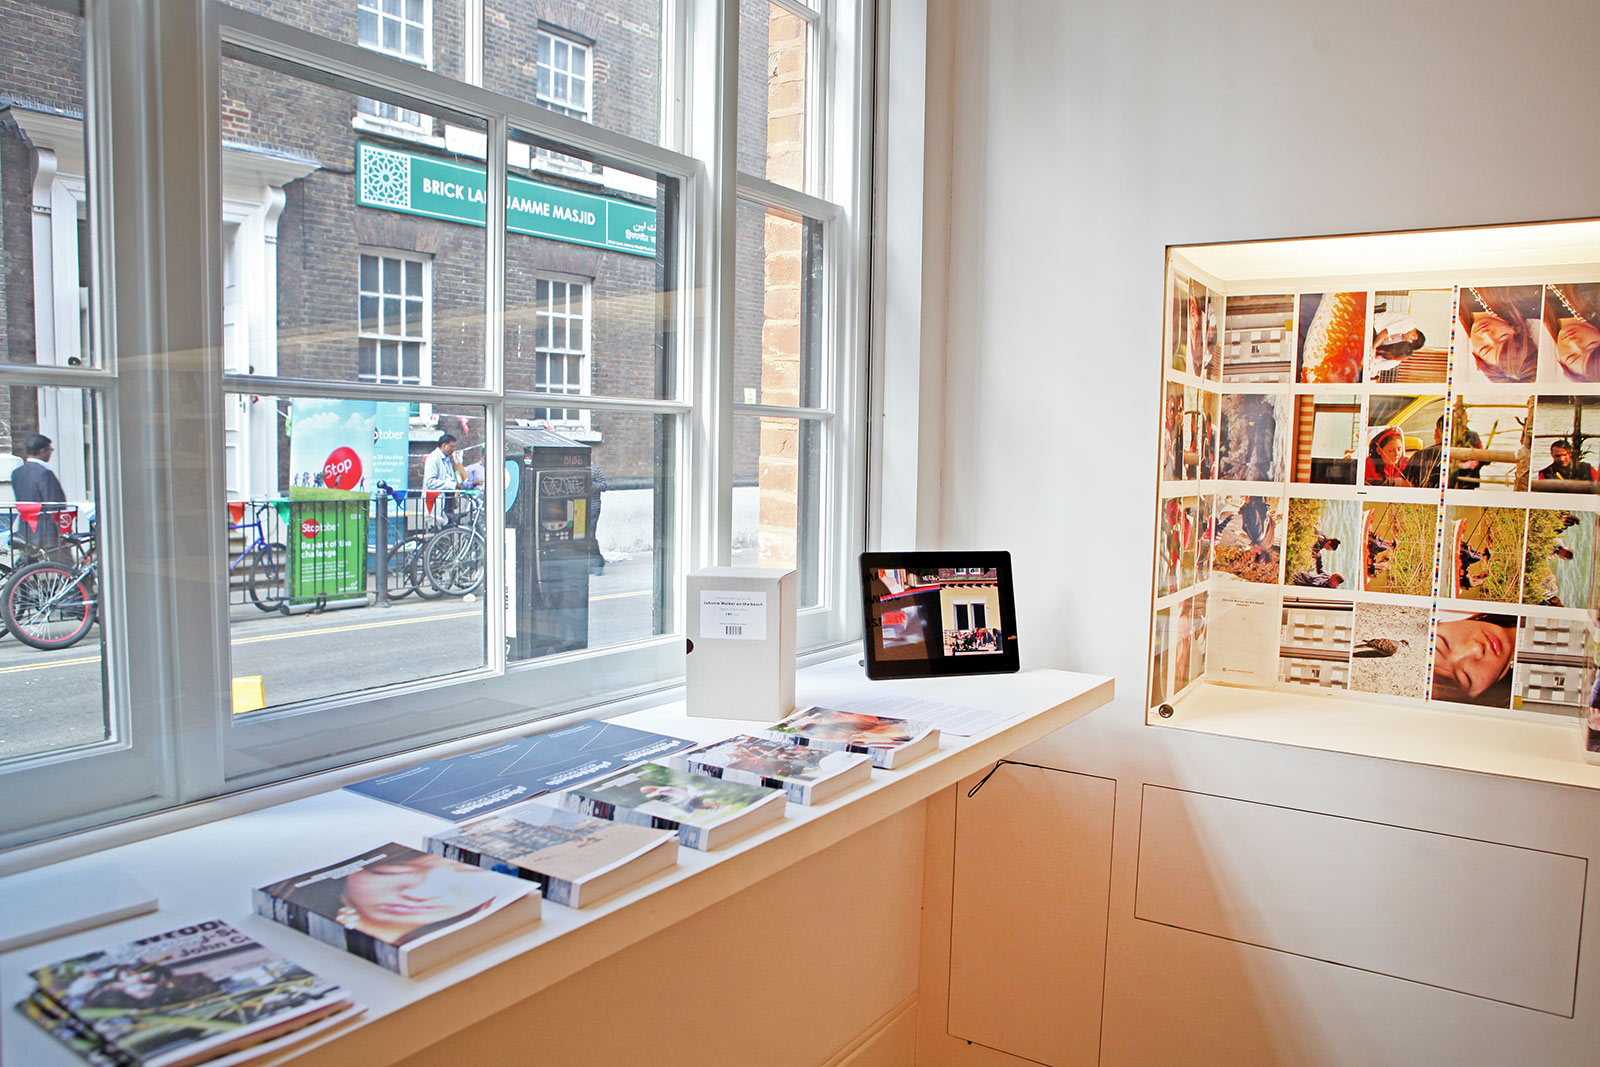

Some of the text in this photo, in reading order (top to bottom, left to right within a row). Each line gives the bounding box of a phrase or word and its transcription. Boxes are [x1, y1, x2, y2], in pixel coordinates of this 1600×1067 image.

[422, 177, 465, 201] BRICK
[506, 195, 551, 218] JAMME
[552, 204, 596, 226] MASJID
[324, 458, 353, 479] Stop
[301, 541, 311, 550] Be
[301, 549, 337, 559] chalenge
